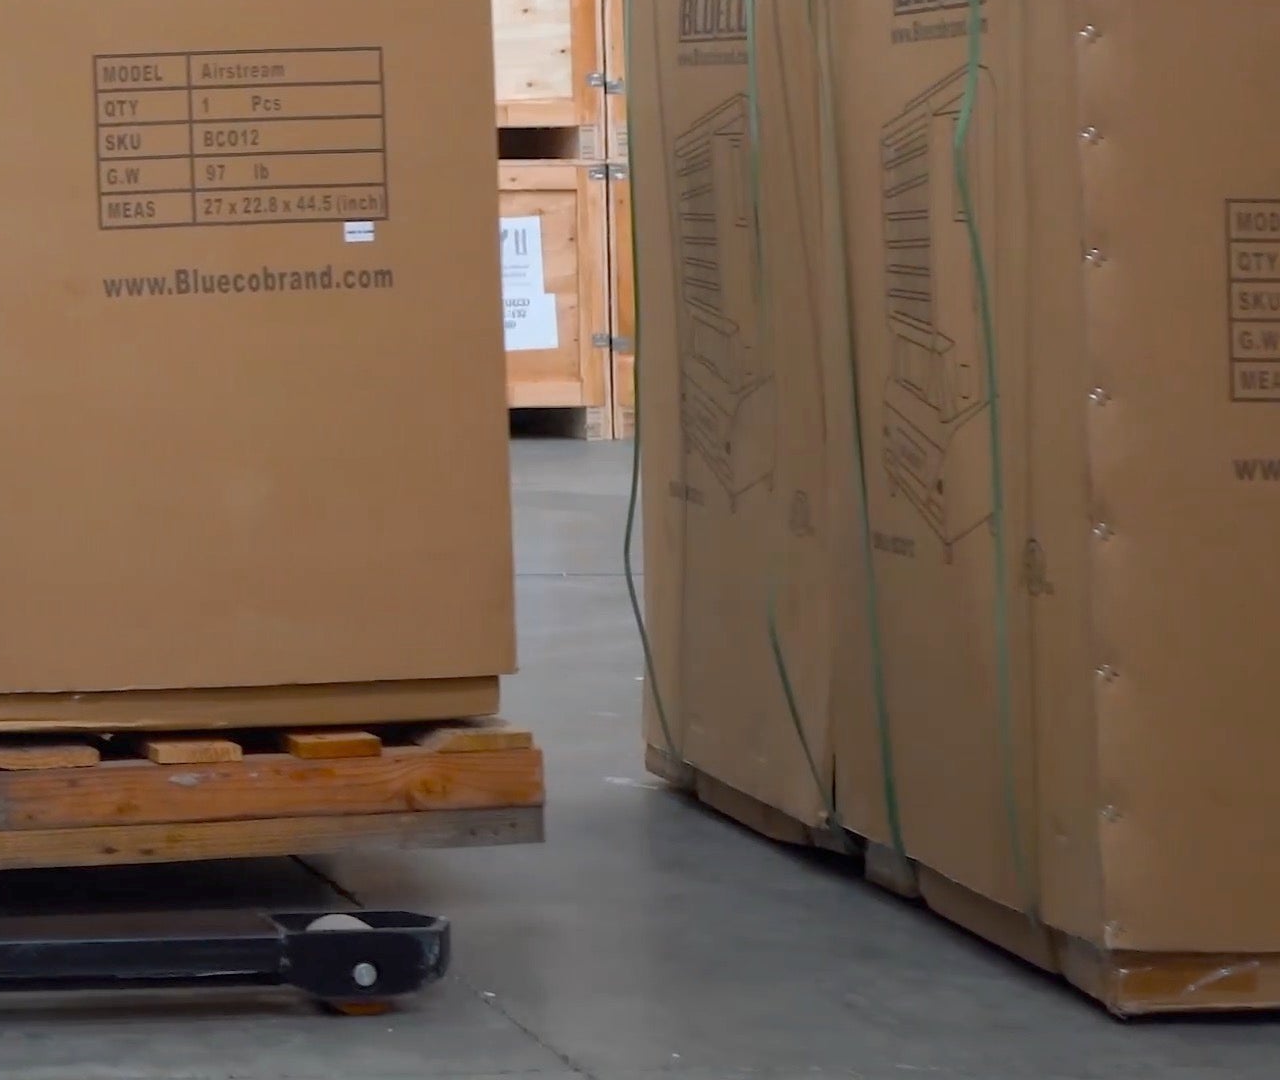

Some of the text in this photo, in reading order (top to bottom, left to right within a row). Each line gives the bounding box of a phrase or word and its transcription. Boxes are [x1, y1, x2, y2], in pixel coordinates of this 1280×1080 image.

[103, 63, 285, 82] MODEL Airstream
[104, 95, 282, 117] QTY 1 Pcs
[105, 133, 141, 151] SKU
[107, 163, 270, 185] G.W 97 lb
[107, 194, 384, 218] MEAS 27 x 22.8 x 44.5 (inch)
[1239, 252, 1279, 271] QTY
[103, 265, 394, 297] www.Bluecobrand.com
